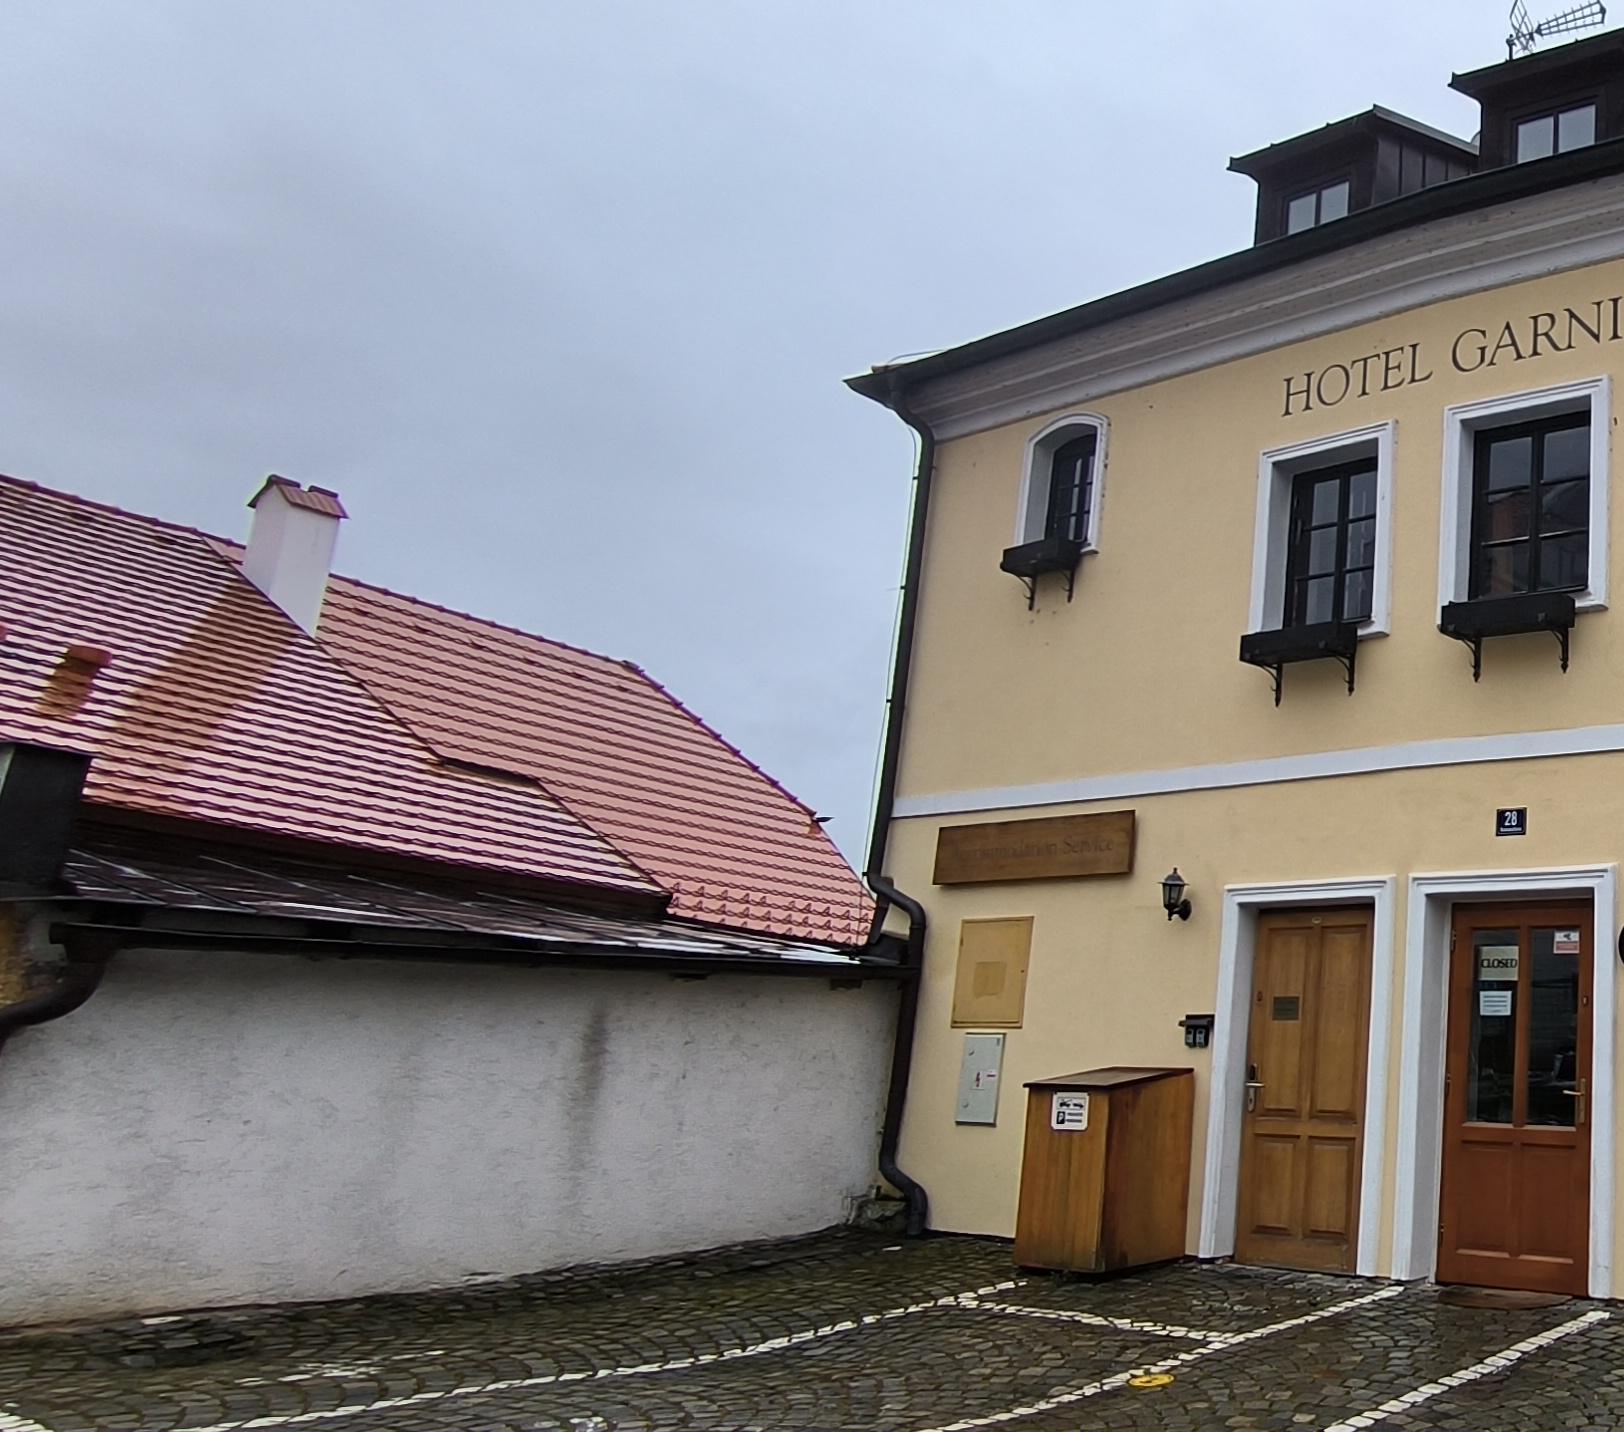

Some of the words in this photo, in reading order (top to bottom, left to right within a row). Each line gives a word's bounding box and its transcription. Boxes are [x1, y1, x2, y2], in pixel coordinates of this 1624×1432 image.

[1281, 342, 1433, 417] HOTEL
[1451, 295, 1623, 373] GARNI
[1504, 811, 1518, 826] 28
[1480, 958, 1518, 969] CLOSED
